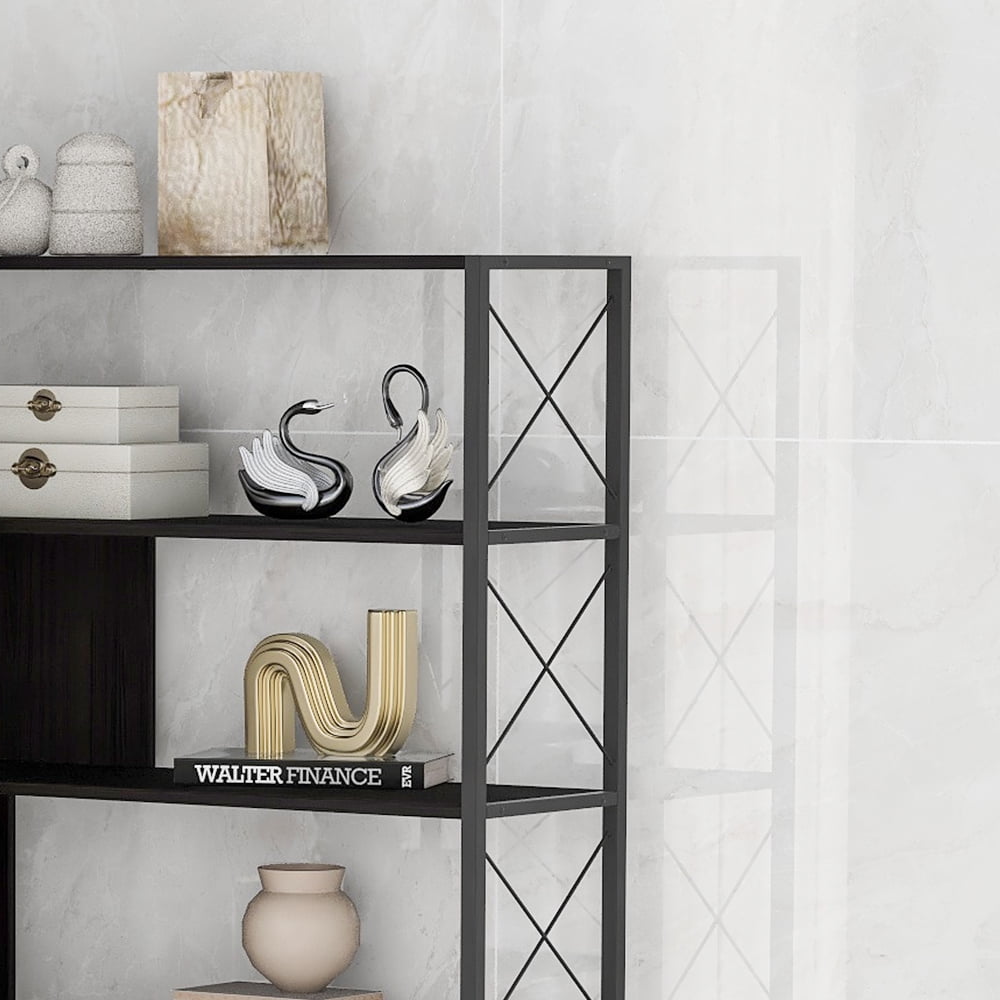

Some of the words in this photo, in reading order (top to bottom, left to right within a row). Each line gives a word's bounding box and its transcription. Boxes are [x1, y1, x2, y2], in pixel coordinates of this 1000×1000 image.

[194, 764, 283, 784] WALTER
[285, 766, 382, 786] FINANCE
[401, 765, 412, 788] EVR
